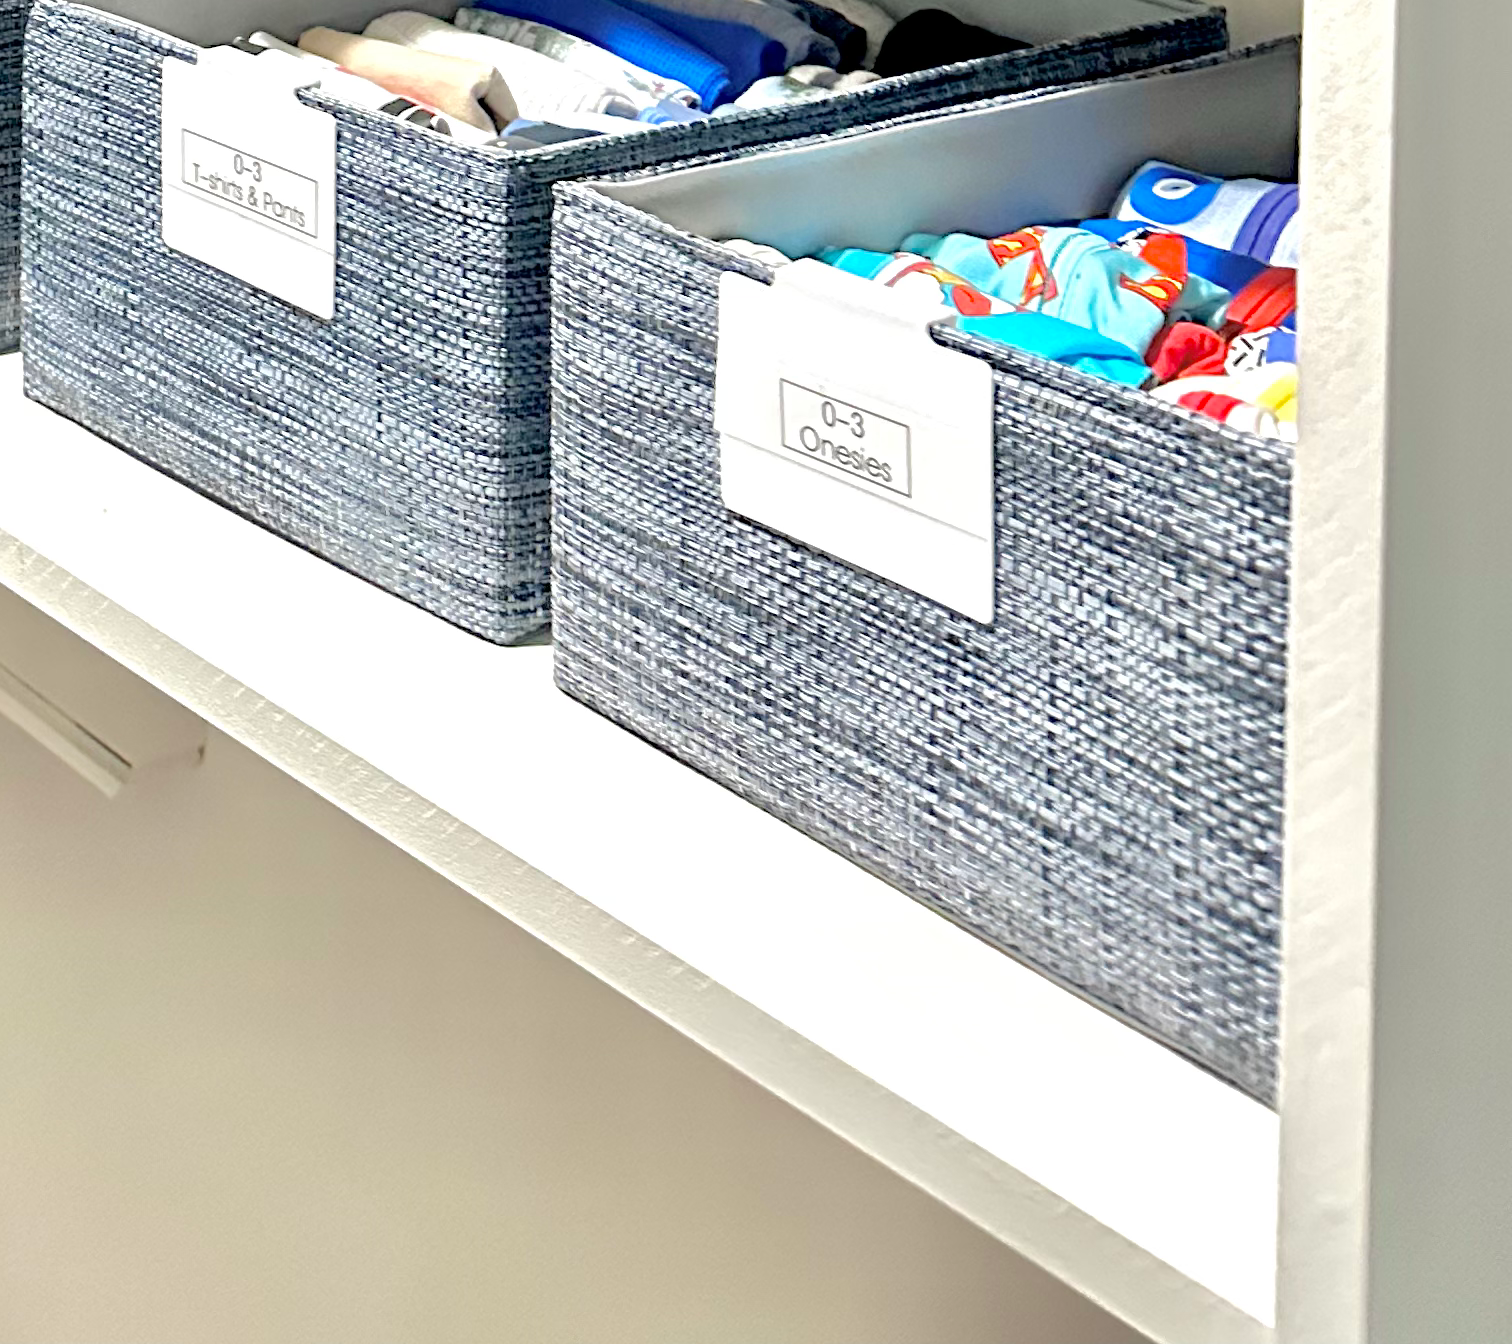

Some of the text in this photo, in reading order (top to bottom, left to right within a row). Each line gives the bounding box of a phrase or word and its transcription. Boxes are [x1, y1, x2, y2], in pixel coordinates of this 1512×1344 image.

[233, 153, 263, 183] 0-3
[192, 162, 306, 228] T-shirts & Pants
[821, 400, 866, 439] 0-3
[798, 425, 893, 483] Onesies
